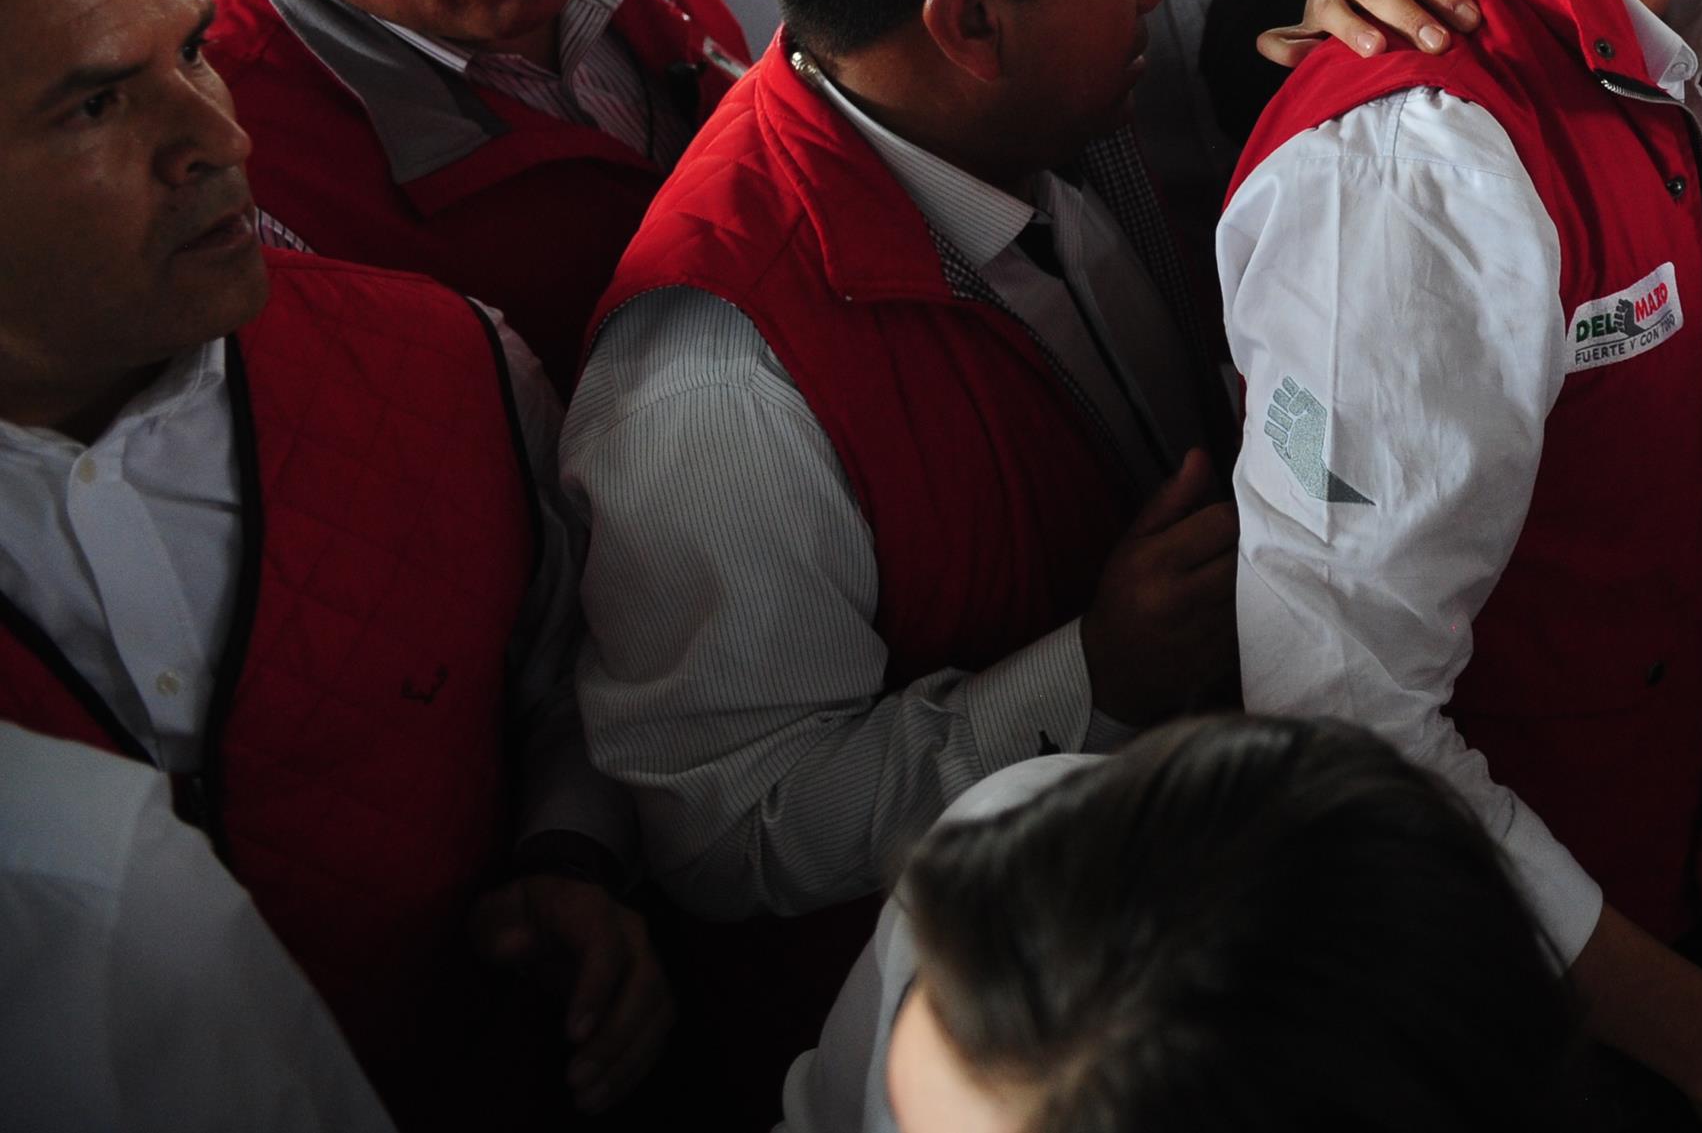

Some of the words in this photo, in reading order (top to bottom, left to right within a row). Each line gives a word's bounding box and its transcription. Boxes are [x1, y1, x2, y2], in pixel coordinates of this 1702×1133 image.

[1575, 312, 1619, 343] DEL
[1574, 342, 1626, 365] FUERTE
[1630, 338, 1638, 350] Y
[1639, 331, 1660, 347] CON
